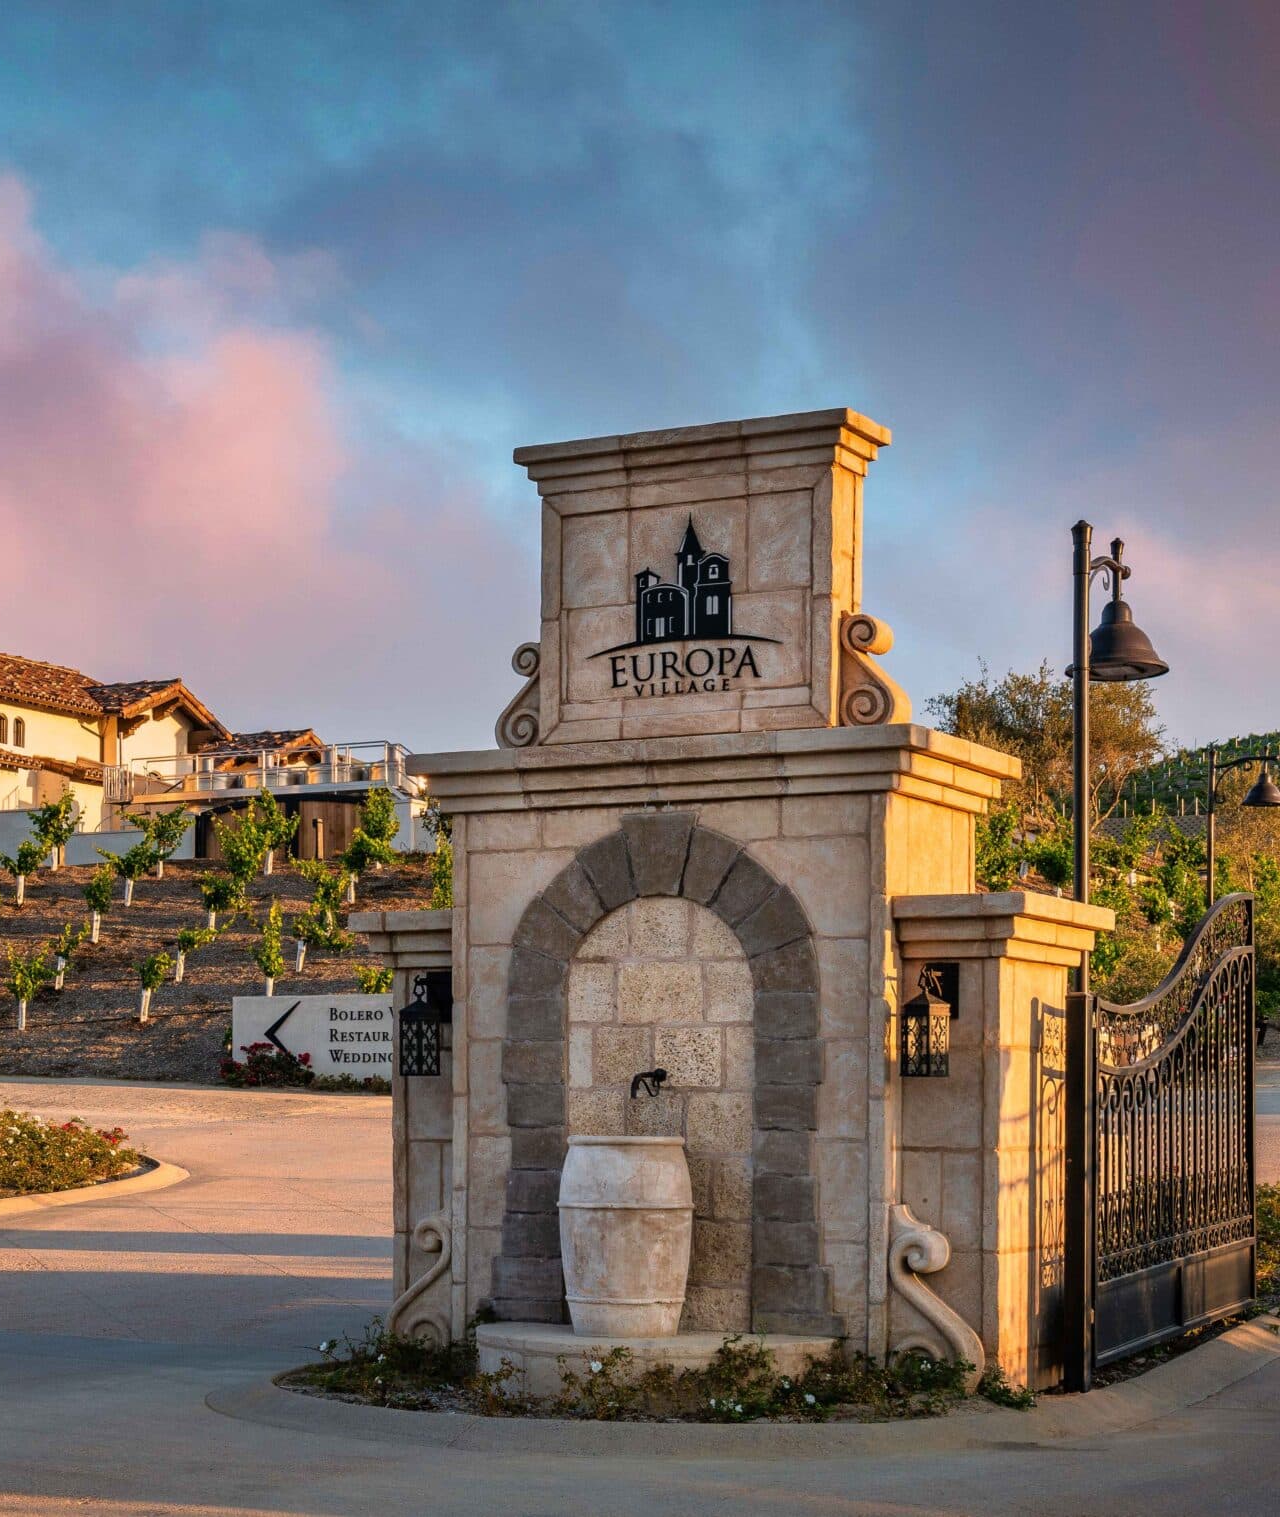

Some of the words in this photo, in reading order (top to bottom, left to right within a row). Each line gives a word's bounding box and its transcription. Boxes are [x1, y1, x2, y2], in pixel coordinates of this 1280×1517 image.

[609, 645, 762, 688] EUROPA
[634, 678, 731, 697] VILLAGE
[329, 1007, 383, 1021] BOLERO
[329, 1028, 393, 1042] RESTAUR
